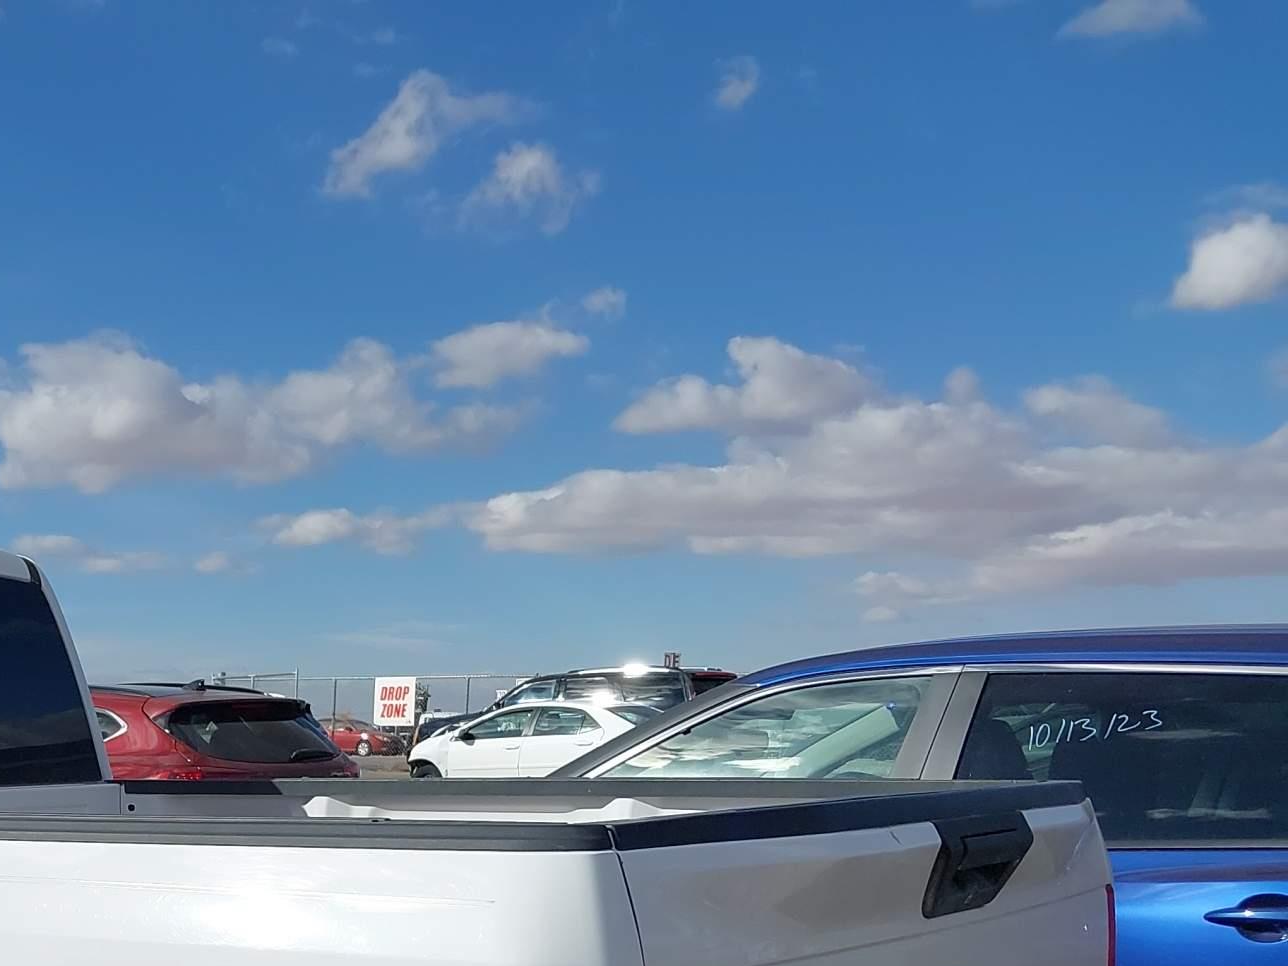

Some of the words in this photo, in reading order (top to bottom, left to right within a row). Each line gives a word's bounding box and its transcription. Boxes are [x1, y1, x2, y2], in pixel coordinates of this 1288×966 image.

[380, 686, 410, 701] DROP
[380, 703, 408, 718] ZONE
[1028, 710, 1163, 751] 10/13/23
